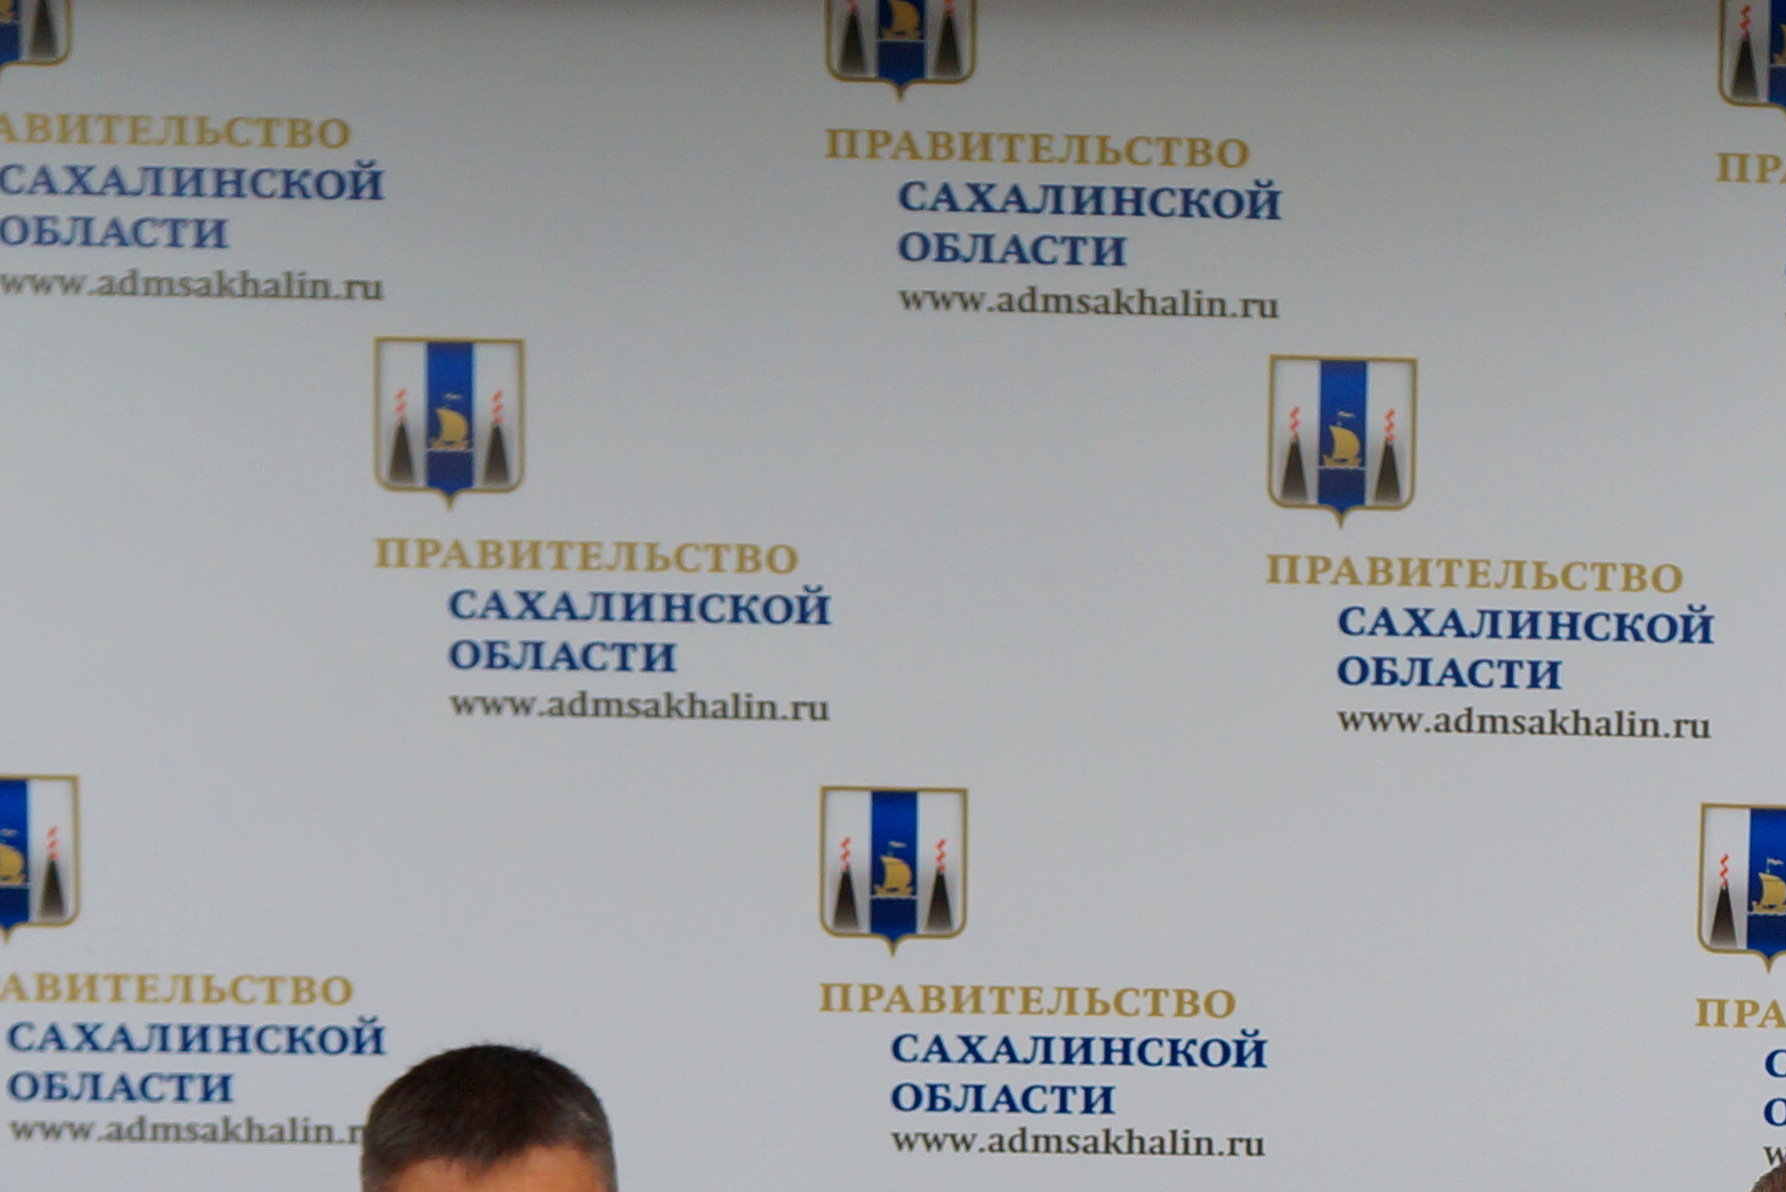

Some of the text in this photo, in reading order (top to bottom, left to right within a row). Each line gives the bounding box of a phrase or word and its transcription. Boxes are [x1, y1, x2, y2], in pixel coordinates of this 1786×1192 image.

[826, 129, 1249, 168] ПРАВИТЕЛЬСТВО
[0, 160, 383, 200] САХАЛИНСКОЙ
[899, 180, 1281, 220] САХАЛИНСКОЙ
[0, 216, 228, 249] ОБЛАСТИ
[899, 232, 1126, 266] ОБЛАСТИ
[0, 269, 384, 301] www.admsakhalin.ru
[899, 286, 1279, 318] www.admsakhalin.ru
[376, 538, 798, 574] ПРАВИТЕЛЬСТВО
[1267, 554, 1683, 593] ПРАВИТЕЛЬСТВО
[449, 586, 830, 625] САХАЛИНСКОЙ
[1339, 604, 1713, 644] САХАЛИНСКОЙ
[449, 640, 675, 672] ОБЛАСТИ
[1338, 656, 1561, 689] ОБЛАСТИ
[451, 690, 829, 721] www.admsakhalin.ru
[1338, 707, 1710, 738] www.admsakhalin.ru
[0, 973, 353, 1006] АВИТЕЛЬСТВО
[820, 983, 1235, 1018] ПРАВИТЕЛЬСТВО
[8, 1017, 384, 1055] САХАЛИНСКОЙ
[892, 1029, 1266, 1068] САХАЛИНСКОЙ
[8, 1073, 232, 1103] ОБЛАСТИ
[892, 1083, 1114, 1114] ОБЛАСТИ
[10, 1115, 368, 1145] www.admsakhalin.r
[892, 1127, 1264, 1156] www.admsakhalin.ru
